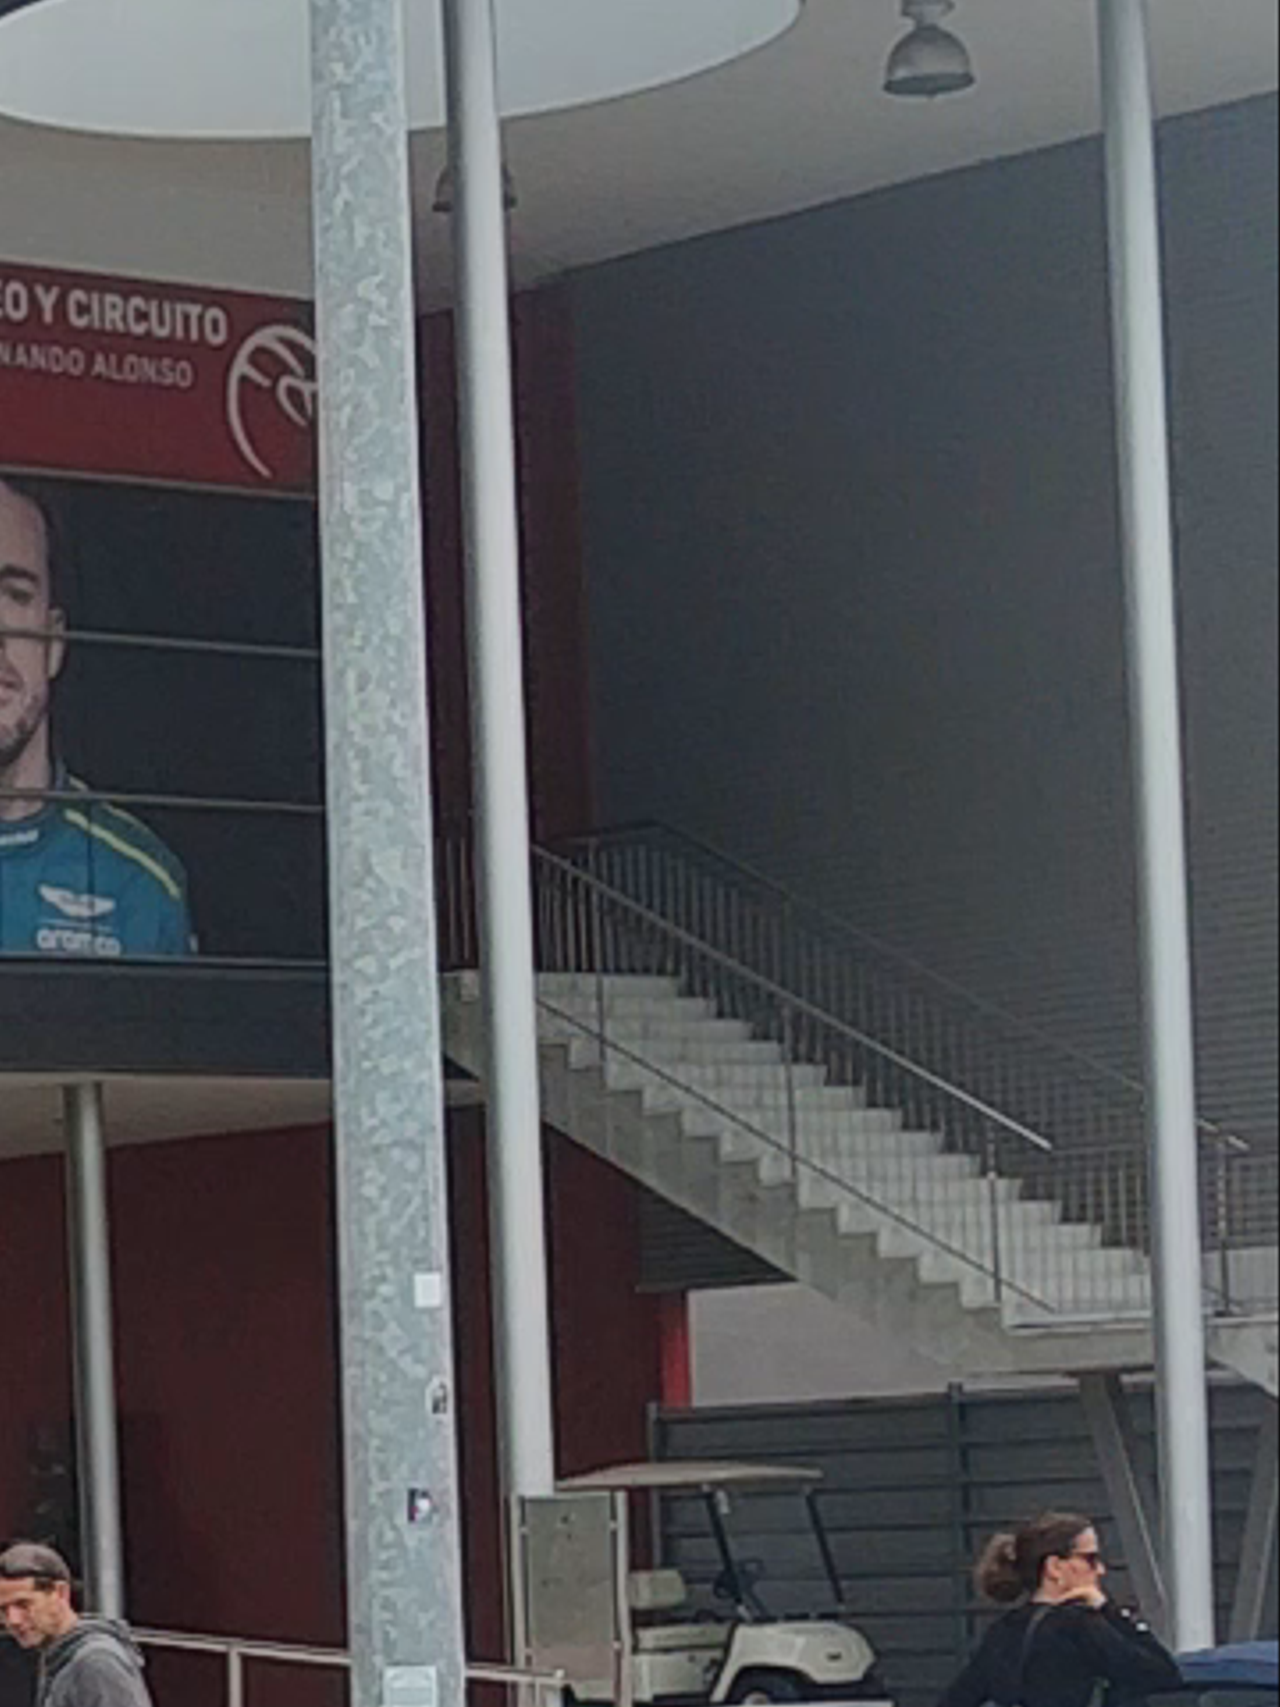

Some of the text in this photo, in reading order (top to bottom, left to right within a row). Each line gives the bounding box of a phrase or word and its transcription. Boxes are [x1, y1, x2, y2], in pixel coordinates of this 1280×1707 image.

[35, 284, 61, 325] Y
[67, 289, 228, 347] CIRCUITO
[90, 351, 195, 389] ALONSO
